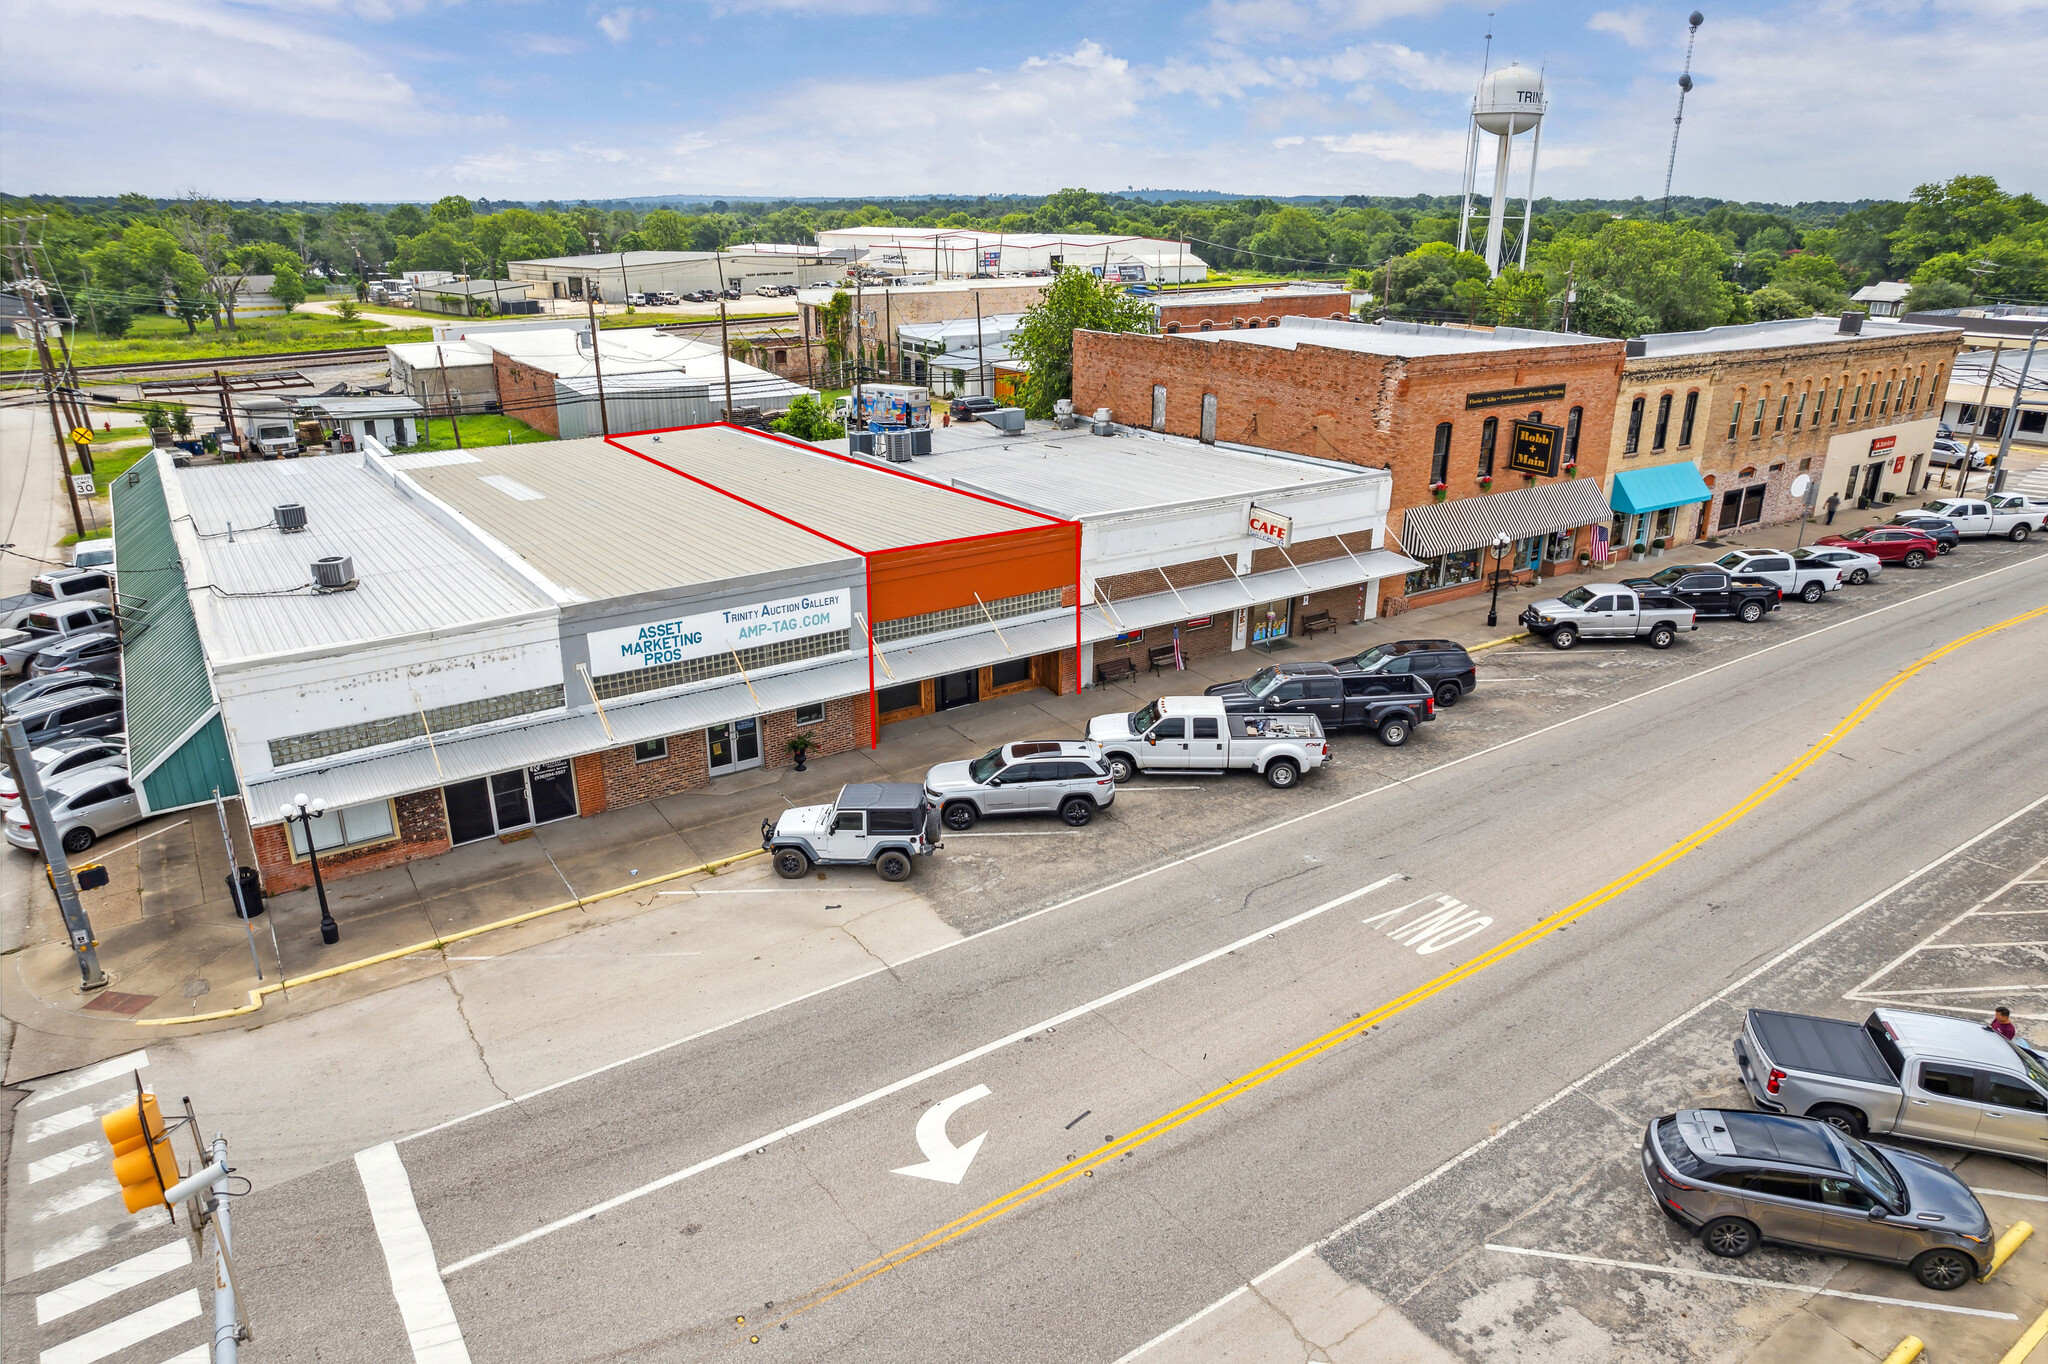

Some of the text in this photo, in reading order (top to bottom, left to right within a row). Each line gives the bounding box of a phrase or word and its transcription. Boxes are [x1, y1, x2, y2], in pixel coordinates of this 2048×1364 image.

[1520, 430, 1549, 445] Robb
[1516, 453, 1545, 467] Main
[77, 484, 93, 493] 30
[1250, 518, 1286, 540] CAFE
[638, 620, 683, 641] ASSET
[621, 631, 703, 657] MARKETING
[644, 648, 682, 666] PROS
[1361, 891, 1494, 955] ONLY
